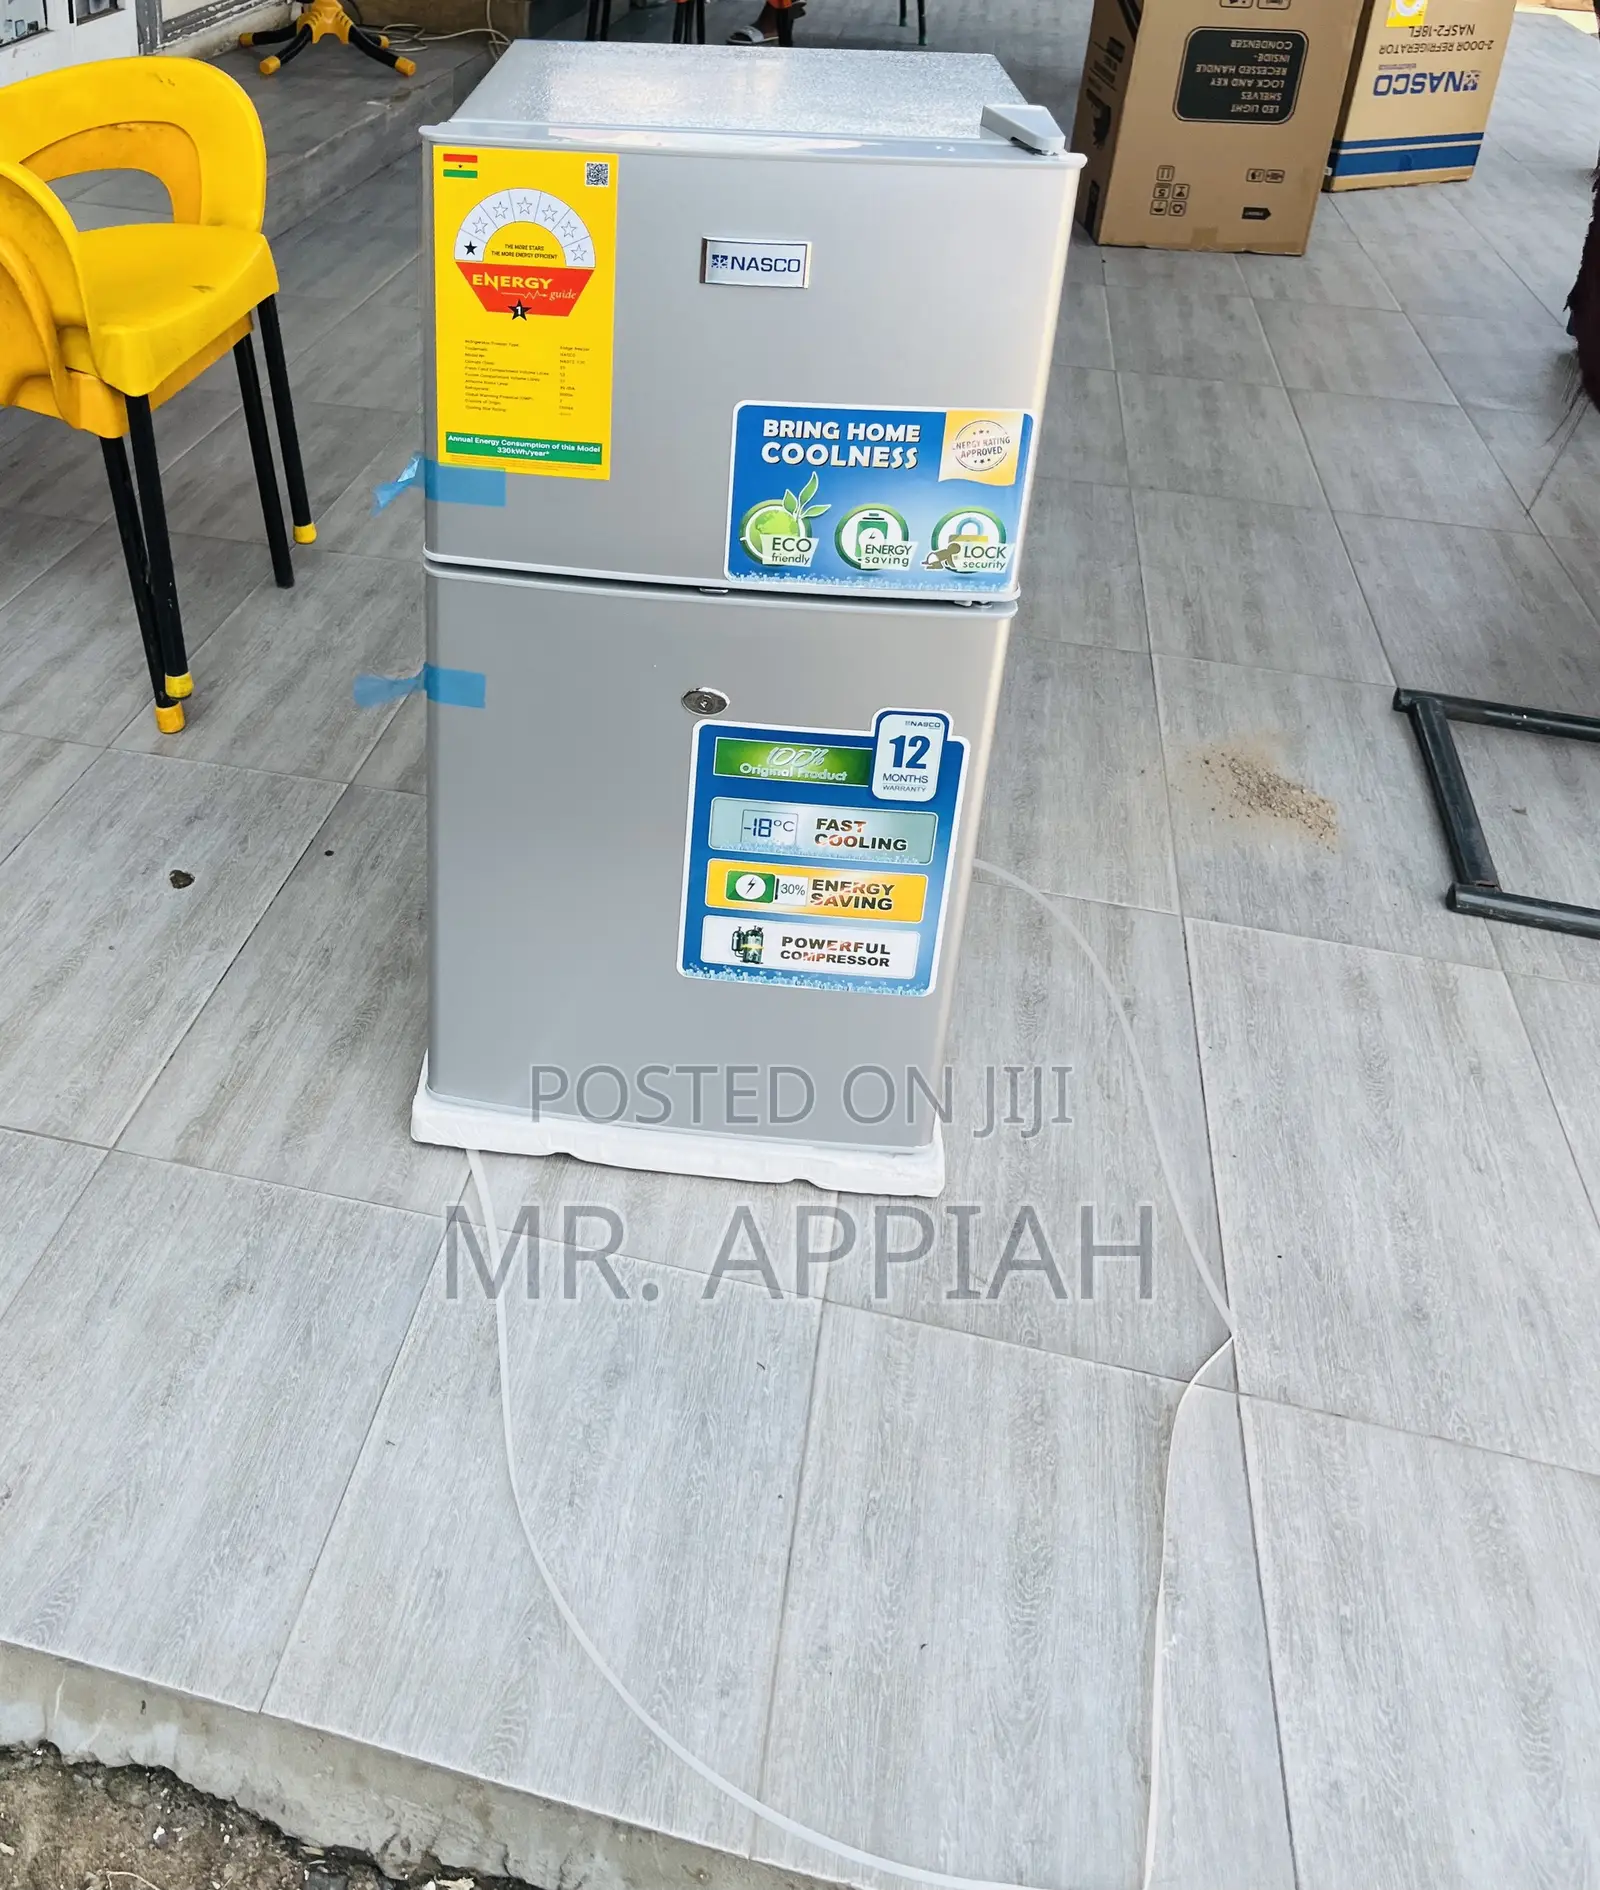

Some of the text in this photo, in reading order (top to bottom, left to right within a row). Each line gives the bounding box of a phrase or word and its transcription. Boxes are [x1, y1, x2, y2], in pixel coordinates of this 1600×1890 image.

[1379, 40, 1495, 54] 2-DOOR REFRIGERATOR
[1195, 64, 1288, 75] RECESSED HANDLE
[1209, 77, 1285, 88] LOCK AND KEY
[1373, 71, 1465, 96] NASCO
[1240, 91, 1283, 101] SHELVES
[1230, 103, 1280, 114] LED LIGHT
[534, 252, 558, 260] EFFICIENT
[730, 256, 801, 273] NASCO
[472, 272, 553, 291] ENERGY
[549, 289, 577, 301] guide
[762, 419, 921, 443] BRING HOME
[448, 435, 473, 444] Annual
[474, 437, 499, 447] Energy
[501, 439, 550, 450] Consumption
[561, 443, 576, 451] this
[576, 445, 601, 453] Model
[761, 442, 920, 471] COOLNESS
[960, 445, 1003, 459] APPROVED
[771, 537, 812, 553] ECO
[865, 544, 912, 556] ENERGY
[963, 545, 1008, 560] LOCK
[771, 552, 811, 567] friendly
[864, 554, 910, 568] saving
[962, 559, 1006, 572] security
[767, 746, 829, 768] 100%
[889, 734, 931, 770] 12
[739, 762, 848, 782] Original Product
[882, 772, 929, 784] MONTHS
[882, 785, 927, 793] WARRANTY
[815, 817, 867, 834] FAST
[814, 832, 908, 852] COOLING
[780, 882, 806, 897] 30%
[812, 878, 896, 897] ENERGY
[810, 892, 893, 911] SAVING
[781, 935, 891, 955] POWERFUL
[780, 949, 890, 968] COMPRESSOR
